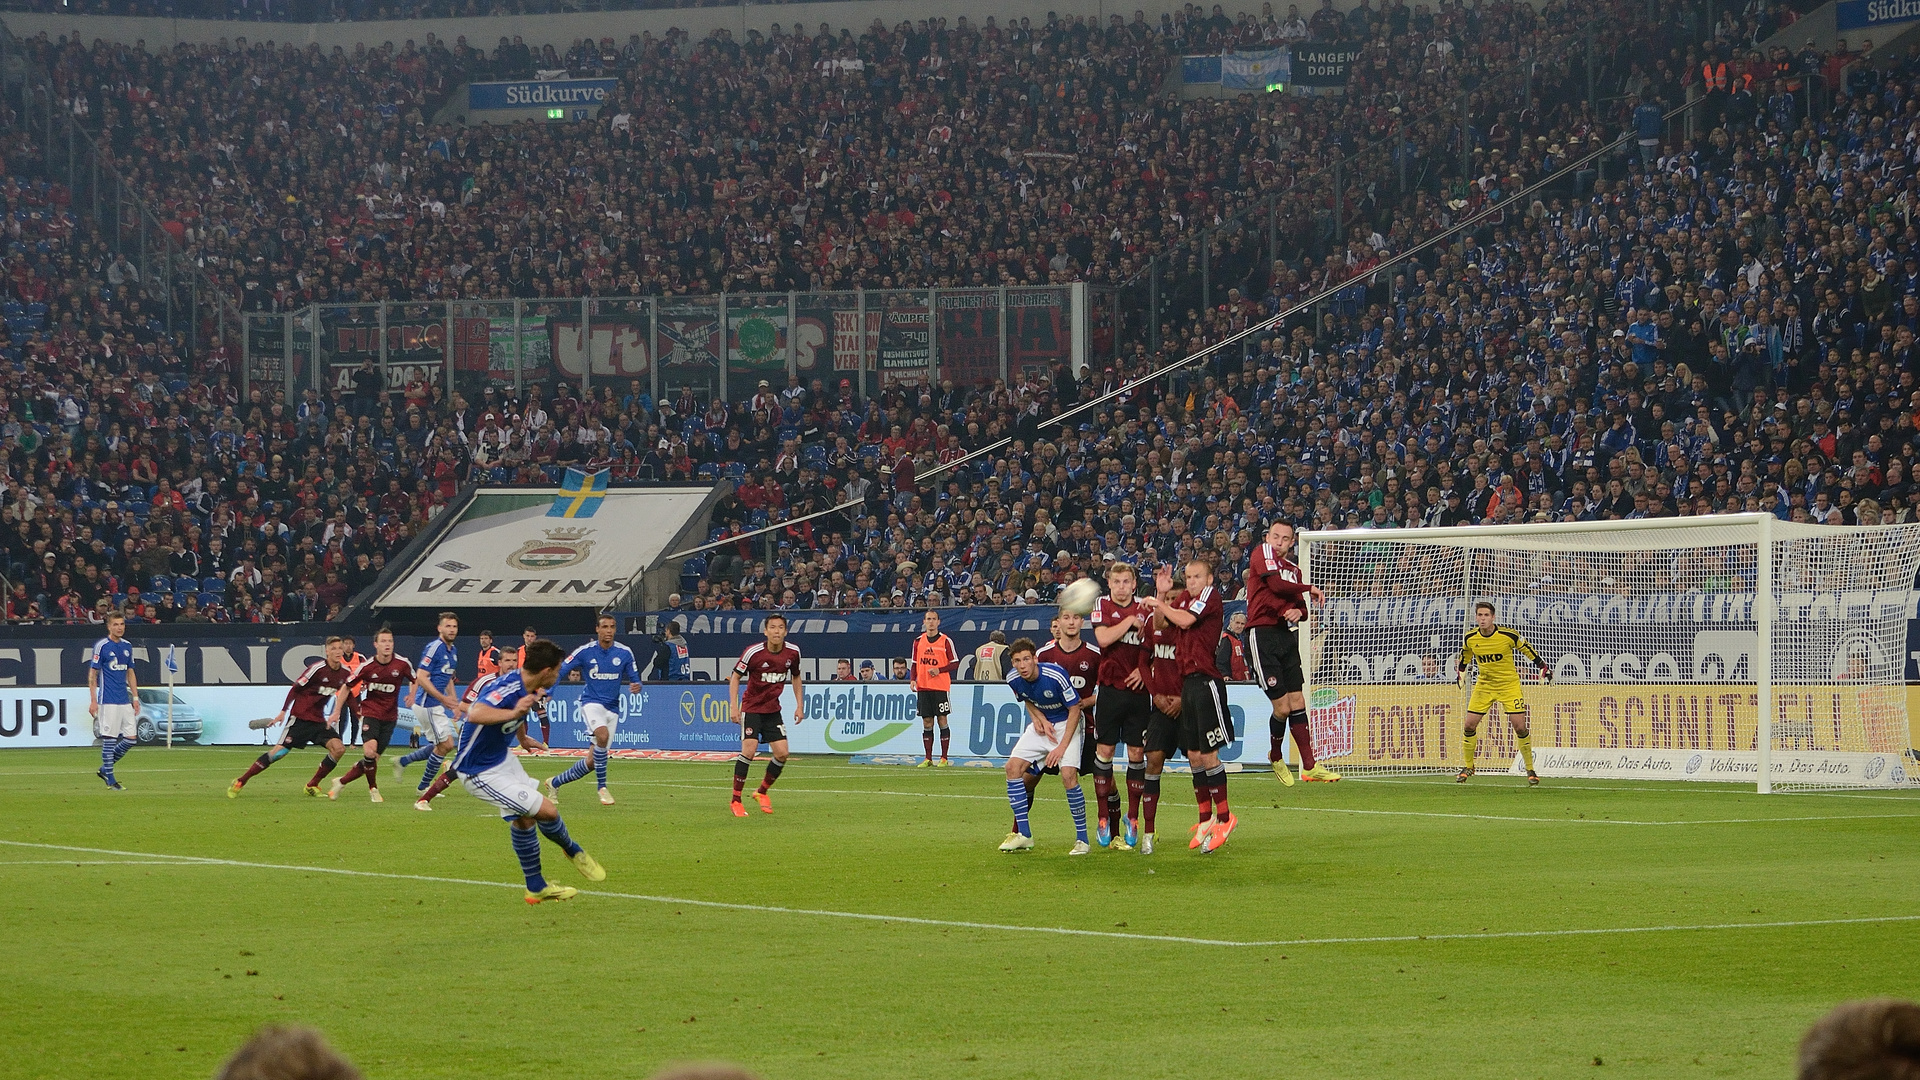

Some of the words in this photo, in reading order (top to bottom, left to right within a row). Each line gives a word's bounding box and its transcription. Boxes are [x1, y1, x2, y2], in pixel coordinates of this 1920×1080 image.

[1299, 51, 1354, 62] LANGEN
[1308, 65, 1344, 76] DORF
[506, 85, 604, 104] Südkurve
[416, 576, 628, 595] VELTINS
[1154, 644, 1177, 660] NK
[920, 657, 938, 667] NKD
[1479, 653, 1504, 664] NKD
[680, 663, 690, 675] 05
[803, 685, 917, 721] bet-at-home
[938, 702, 949, 713] 38
[841, 721, 865, 734] .com
[1368, 702, 1450, 761] DON'T
[1554, 702, 1582, 748] IT
[679, 732, 689, 741] Part
[689, 732, 695, 742] of
[695, 732, 703, 742] the
[703, 733, 721, 742] Thomas
[722, 734, 733, 743] Cook
[1543, 755, 1612, 772] Volkswagen.
[1617, 755, 1642, 771] Das
[1644, 755, 1673, 771] Auto.
[1709, 757, 1784, 774] Volkswaen.
[1789, 758, 1814, 773] Das
